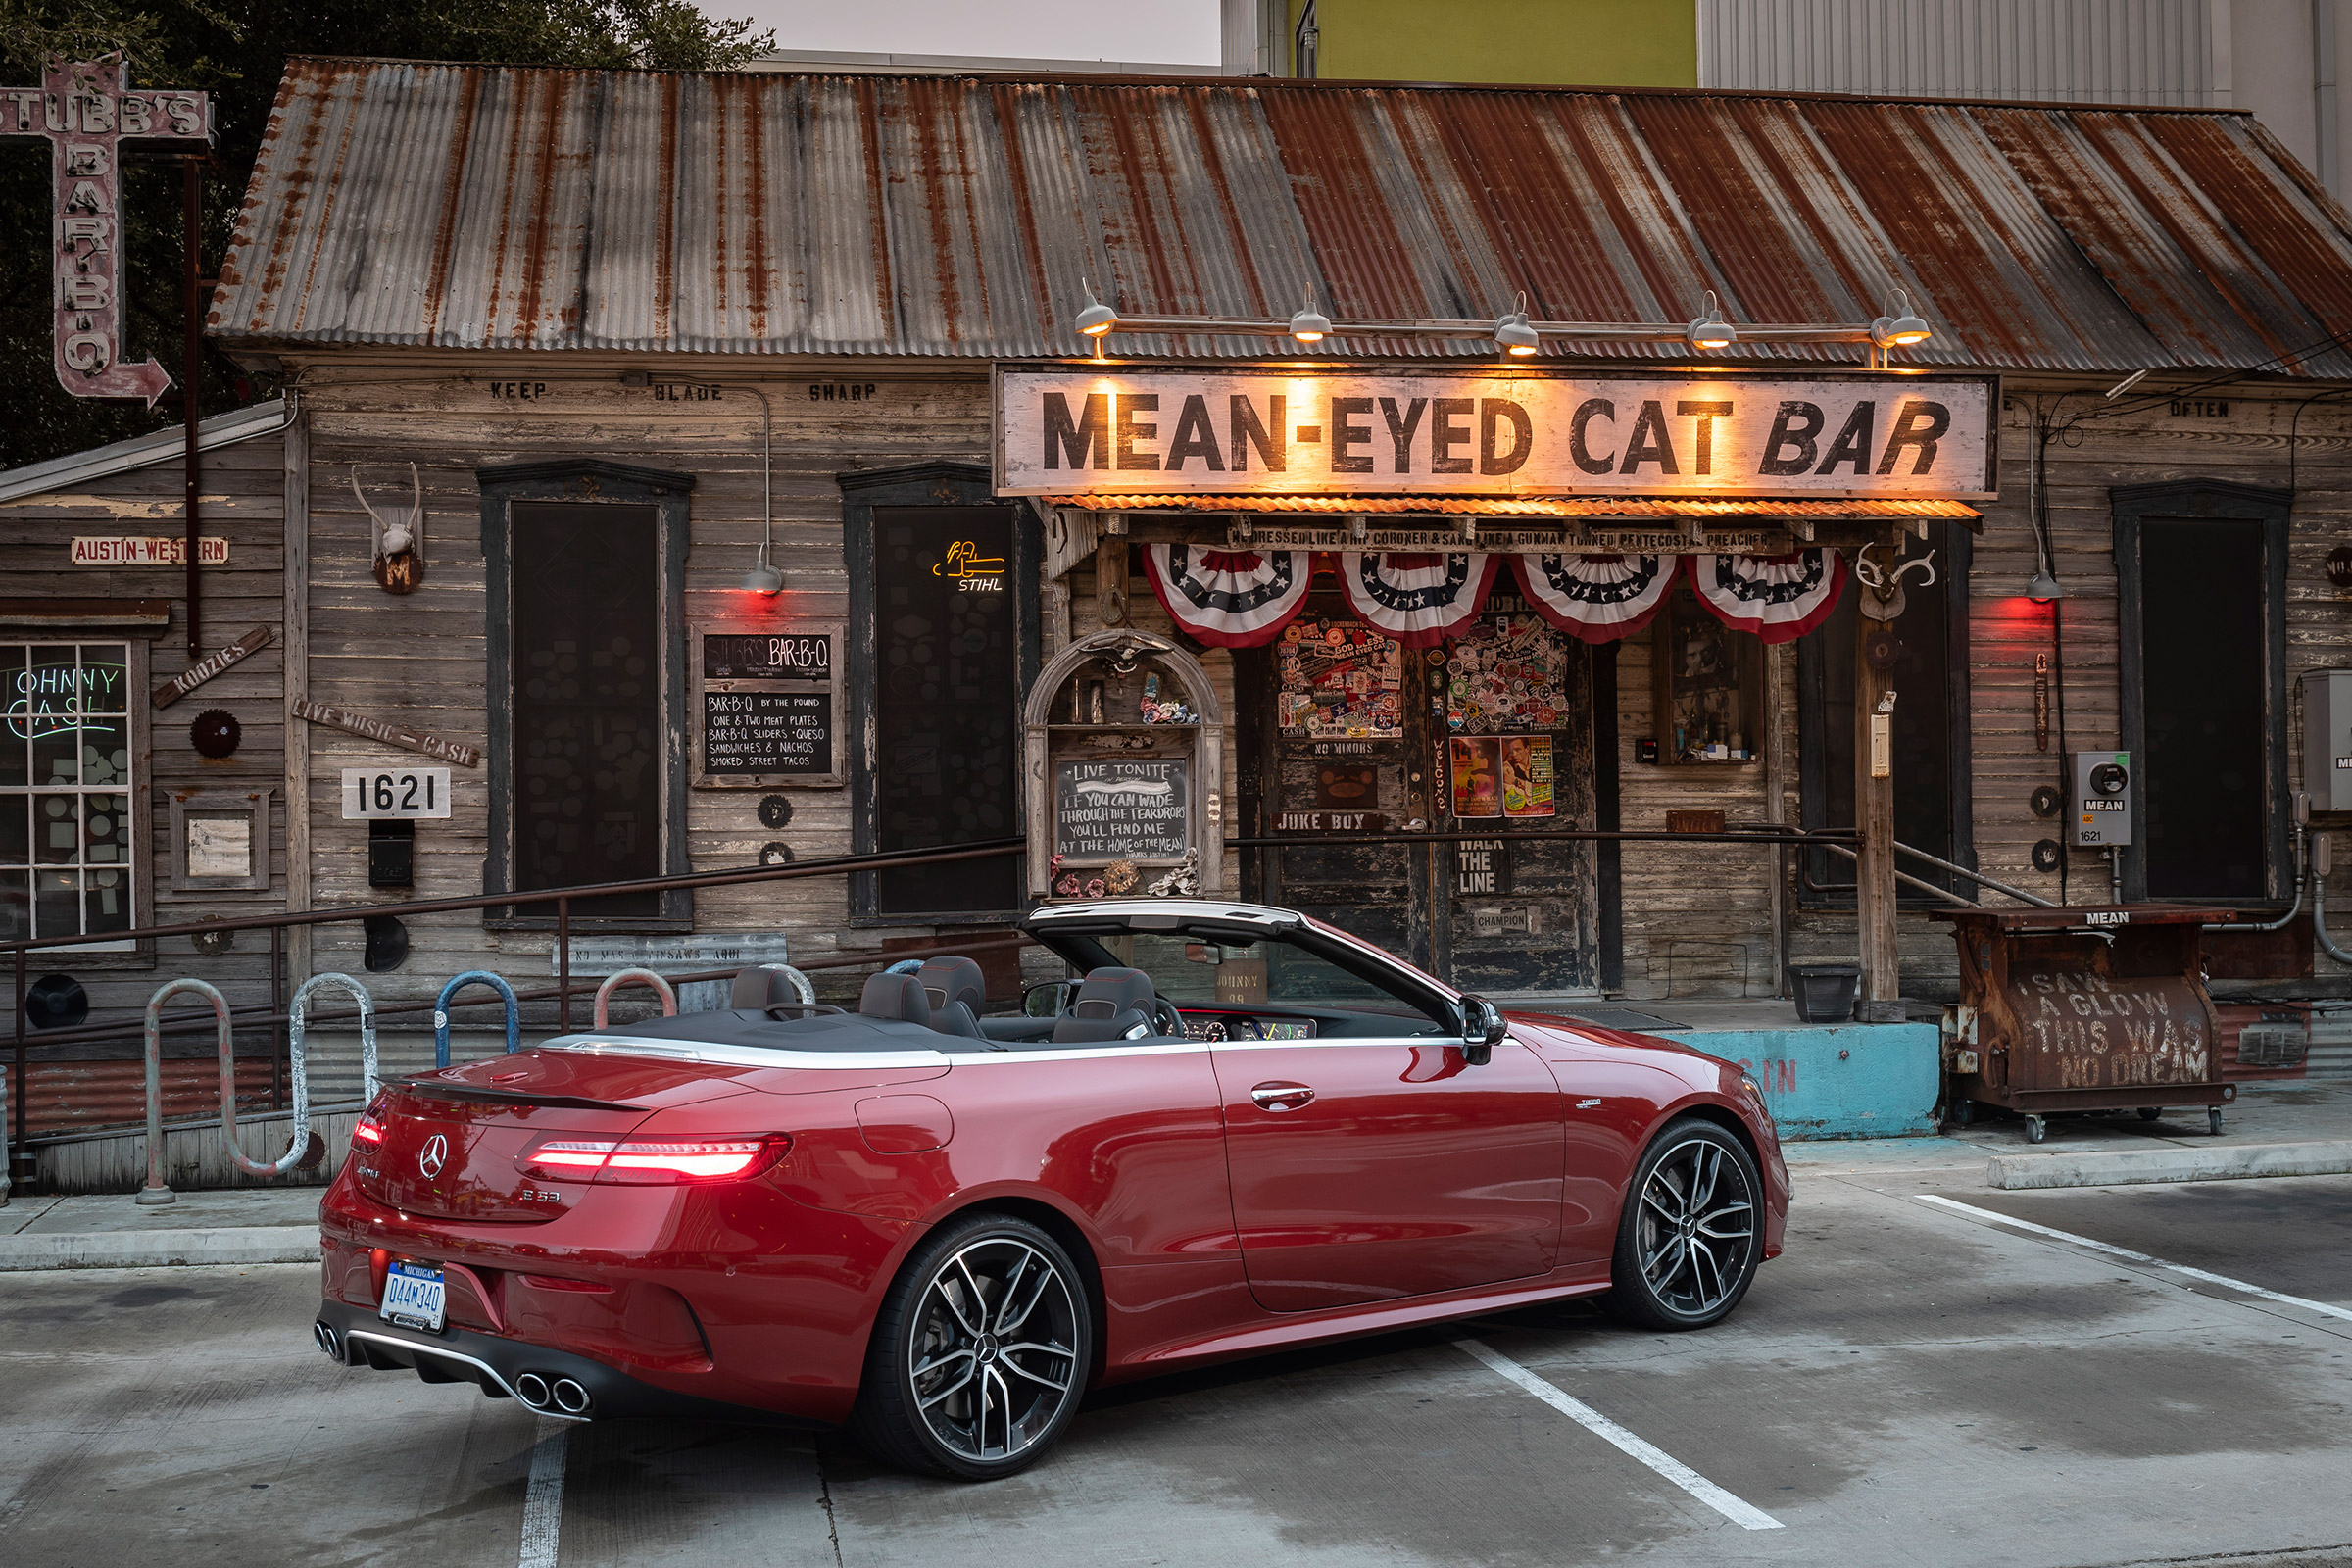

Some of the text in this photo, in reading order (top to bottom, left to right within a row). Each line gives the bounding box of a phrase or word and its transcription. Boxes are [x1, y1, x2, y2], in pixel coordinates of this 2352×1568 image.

[0, 93, 201, 133] TUBB'S
[491, 382, 876, 402] KEEP BLADE SHARP
[2170, 401, 2230, 417] OFTEN
[1571, 397, 1732, 476] CAT
[1759, 400, 1952, 478] BAR
[1253, 531, 1305, 543] DRESSED
[1309, 531, 1336, 545] LIKE
[1341, 532, 1348, 545] A
[1374, 532, 1427, 545] CORONER
[1432, 532, 1440, 545] &
[1518, 532, 1565, 545] GUNMAN
[958, 578, 1003, 592] STIHL
[768, 638, 828, 666] BAR-B-Q
[1335, 643, 1353, 655] GOD
[708, 696, 753, 711] BAR-B-Q
[713, 715, 818, 726] ONE & TWO MEAT PLATES
[293, 699, 335, 723] LIVE
[422, 736, 471, 764] CASH
[709, 728, 748, 741] BAR-B-Q
[753, 729, 788, 740] SLIDERS
[709, 743, 814, 754] SANDWICHES & NACHOS
[1315, 743, 1373, 755] NO MINORS
[710, 756, 810, 767] SMOKED STREET TACOS
[1074, 764, 1170, 781] LIVE TONITE
[359, 774, 434, 811] 1621
[1085, 793, 1109, 807] YOU
[1111, 793, 1135, 807] CAN
[1139, 793, 1174, 807] WADE
[2085, 800, 2124, 811] MEAN
[1060, 806, 1186, 823] THROUGH THE TEARDROPS
[1278, 813, 1365, 830] JUKE BOX
[1069, 822, 1165, 838] YOU'LL FIND ME
[2081, 831, 2101, 841] 1621
[1059, 841, 1076, 853] AT
[1080, 840, 1104, 852] THE
[1107, 839, 1134, 853] HOME
[1145, 839, 1158, 848] THE
[1459, 852, 1491, 871] THE
[1459, 872, 1495, 893] LINE
[1478, 915, 1525, 926] CHAMPION
[2086, 911, 2131, 925] MEAN
[1216, 975, 1258, 987] JOHNNY
[2032, 969, 2110, 994] SAW
[2039, 992, 2169, 1017] A GLOW
[2033, 1018, 2203, 1054] THIS WAS
[2061, 1050, 2208, 1088] NO DREAM
[522, 1190, 561, 1202] E 53
[403, 1265, 435, 1279] MICHIGAN
